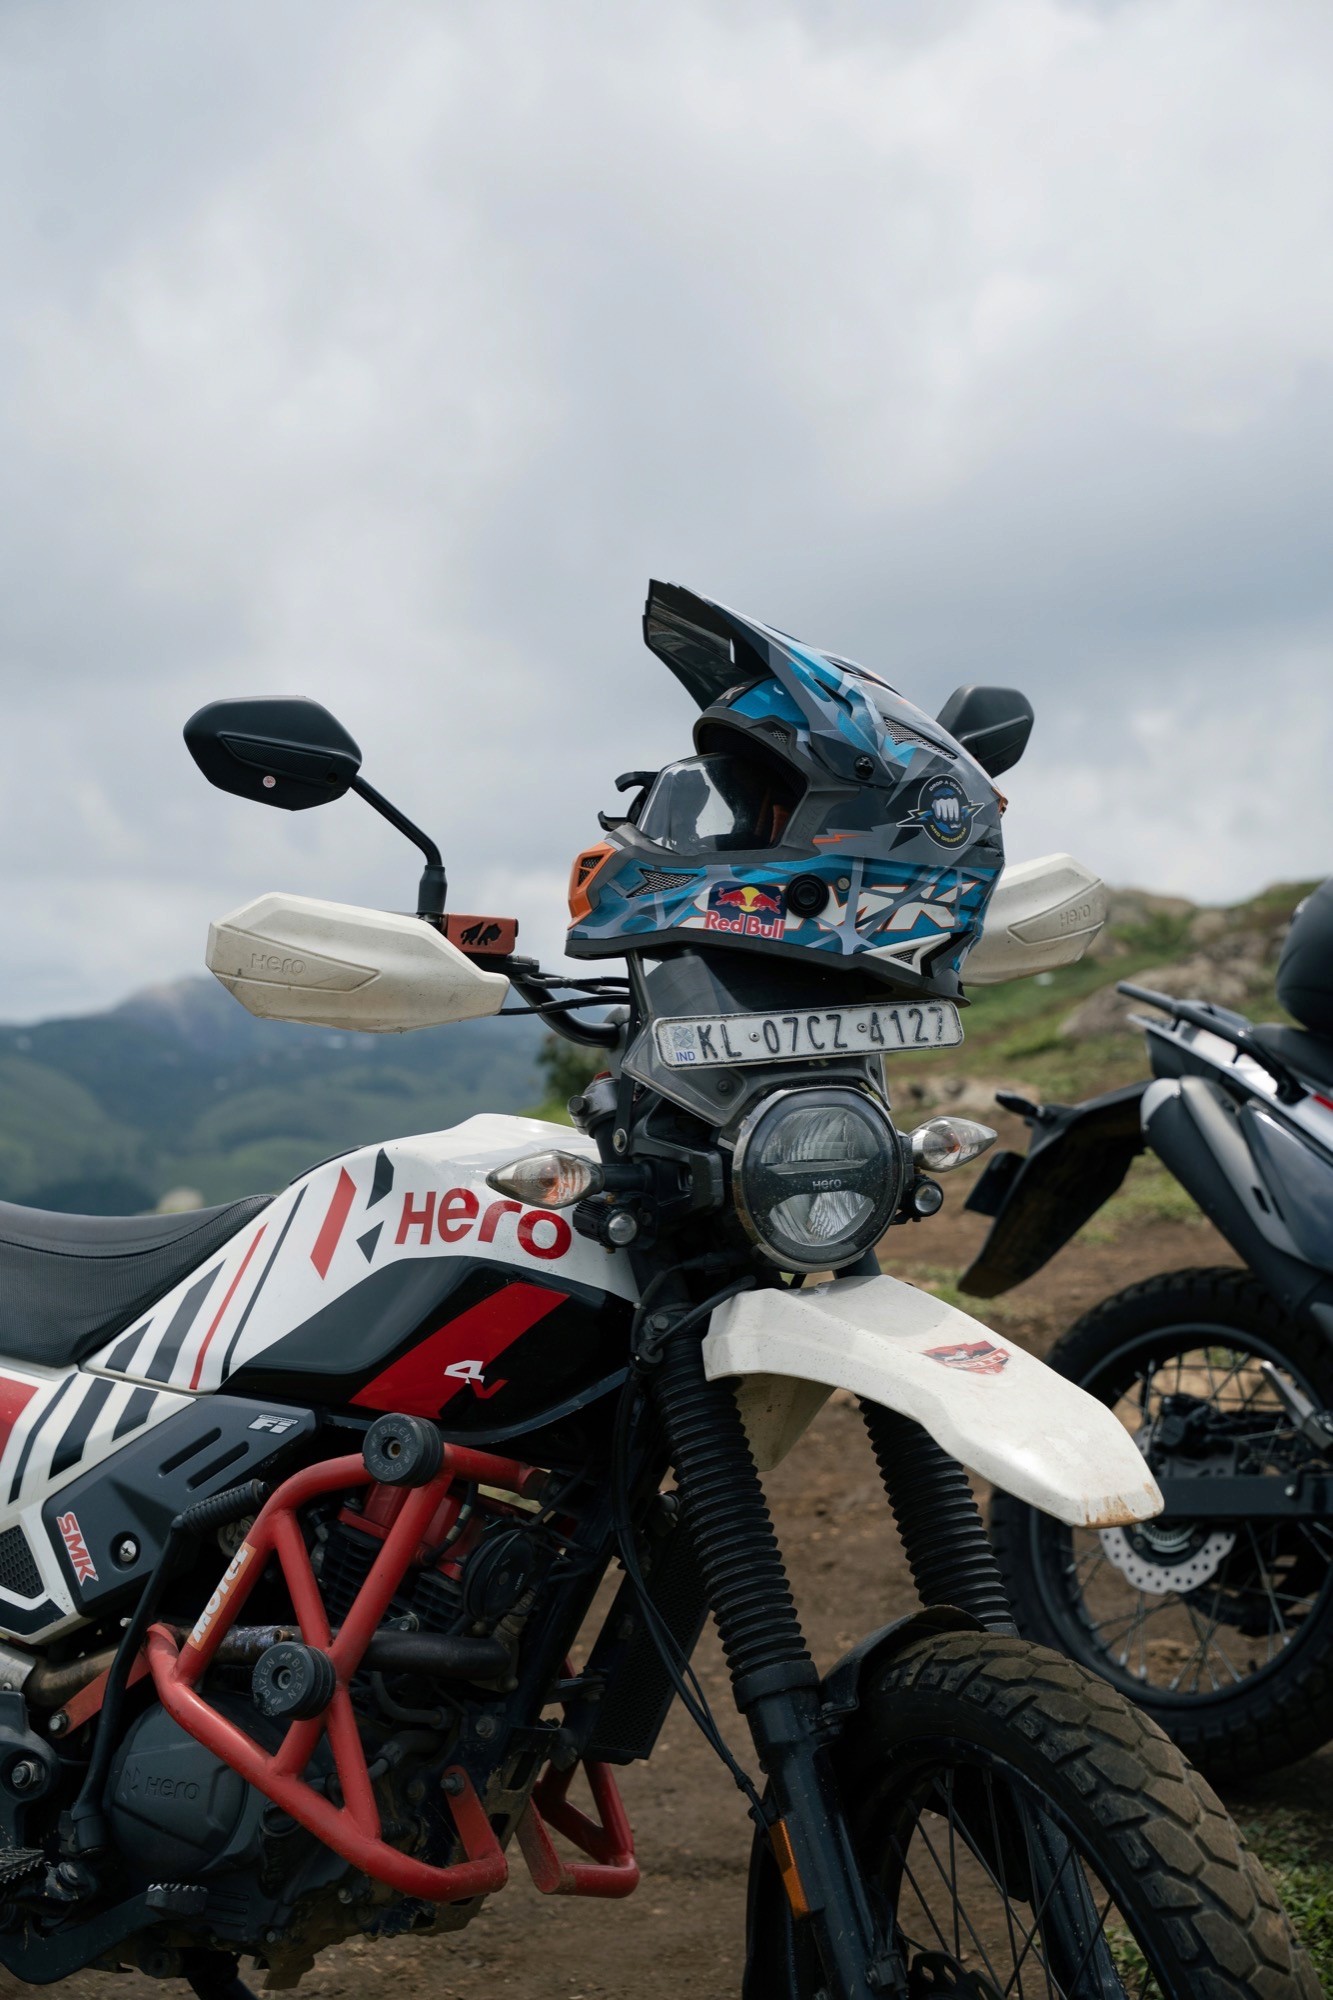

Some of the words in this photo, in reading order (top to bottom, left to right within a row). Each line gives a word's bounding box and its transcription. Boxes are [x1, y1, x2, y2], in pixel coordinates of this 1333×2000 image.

[704, 910, 745, 934] Red
[745, 914, 785, 939] Bull
[250, 953, 306, 976] Hero
[697, 1024, 742, 1058] KL
[762, 1014, 848, 1053] 07CZ
[868, 1006, 944, 1045] 4127
[675, 1051, 696, 1062] IND
[812, 1178, 842, 1190] Hero
[395, 1187, 572, 1260] Hero
[380, 1423, 412, 1443] BIZEN
[57, 1512, 99, 1586] SMK
[259, 1658, 275, 1699] BIZEN
[287, 1658, 304, 1699] BIZEN
